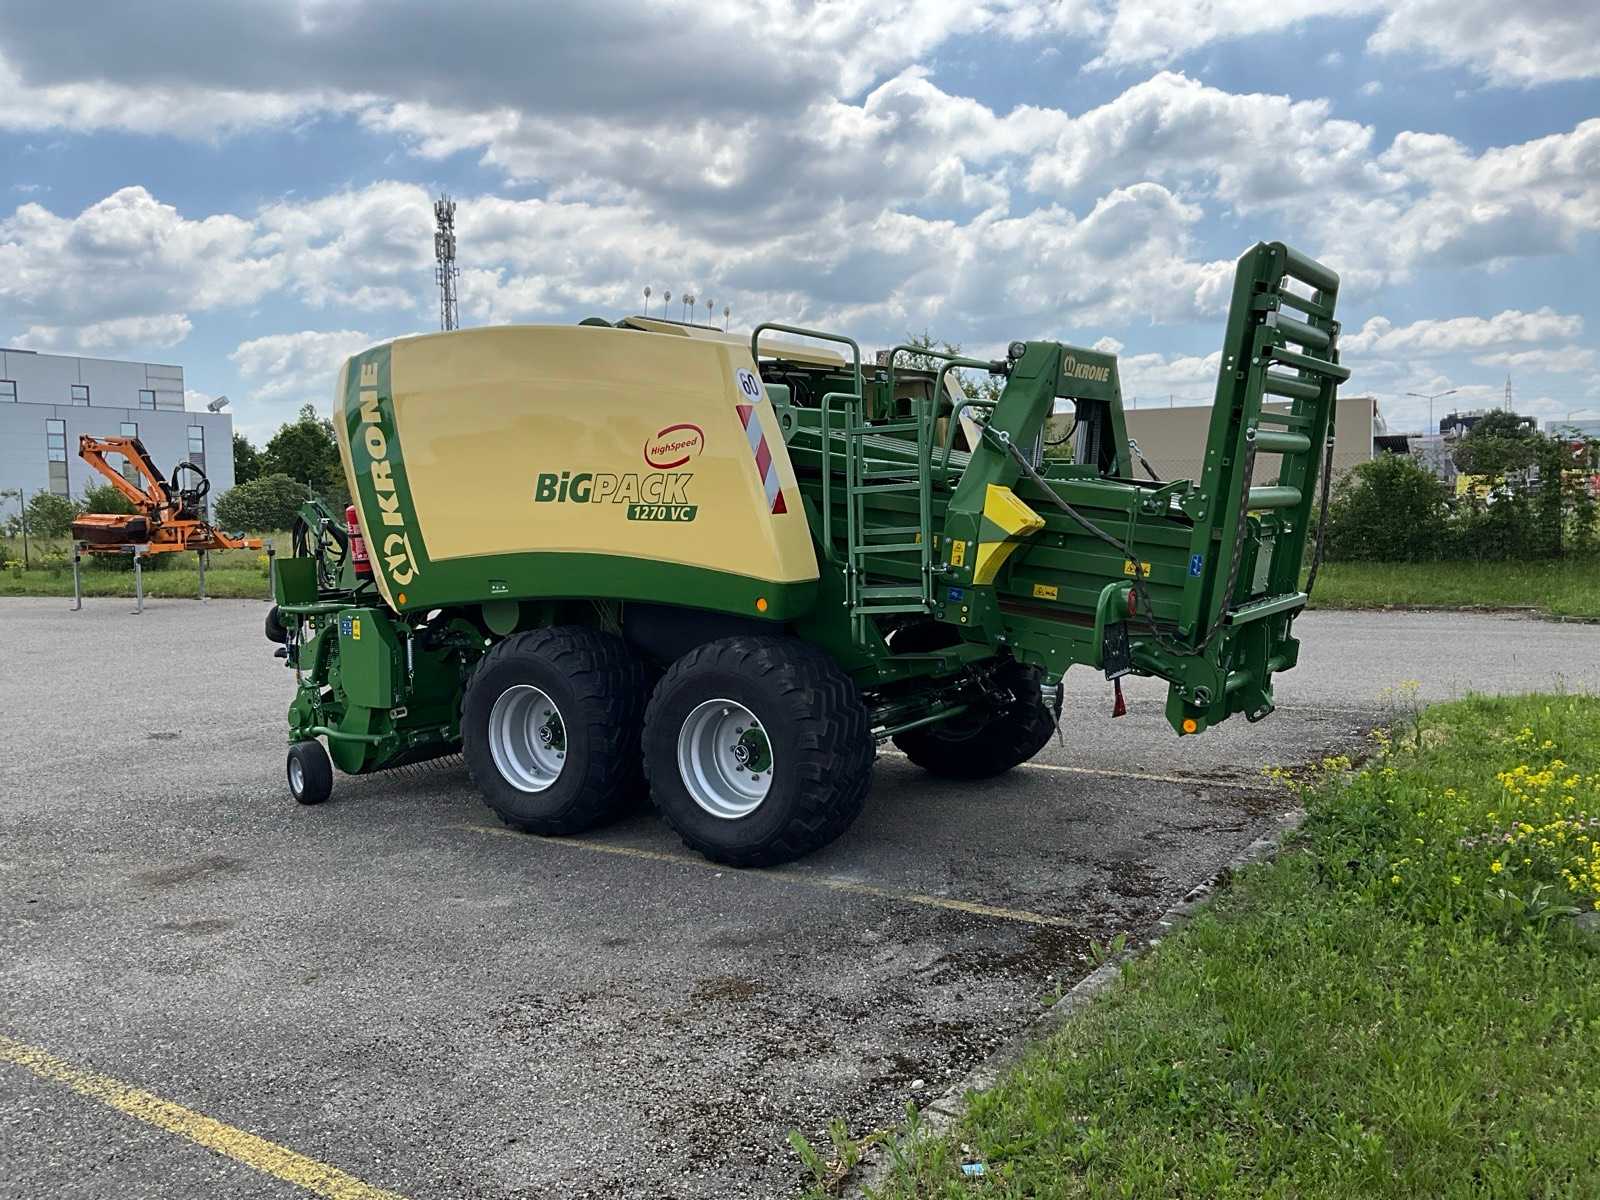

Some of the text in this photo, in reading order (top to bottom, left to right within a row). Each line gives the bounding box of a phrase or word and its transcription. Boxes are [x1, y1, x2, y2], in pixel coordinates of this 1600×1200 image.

[1074, 363, 1110, 382] KRONE
[739, 373, 759, 396] 60
[360, 362, 404, 526] KRONE
[651, 436, 698, 456] HighSpeed
[633, 505, 690, 521] 1270 VC
